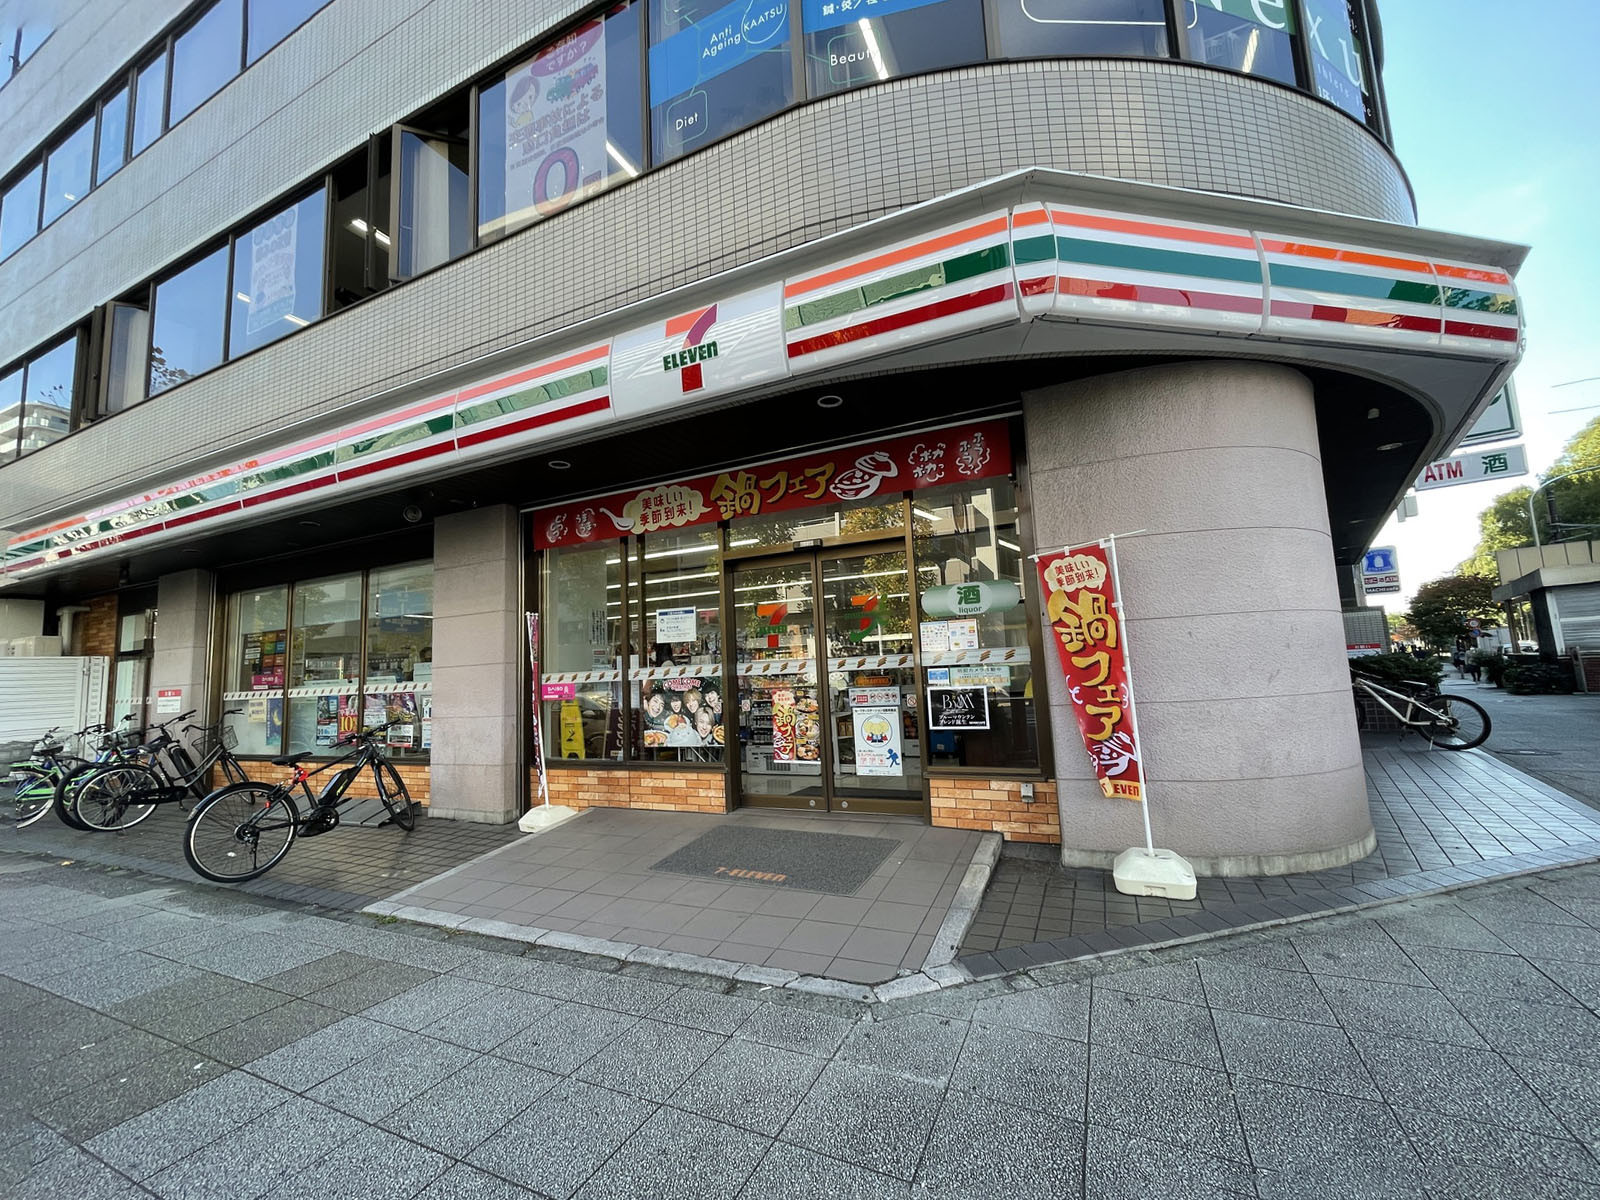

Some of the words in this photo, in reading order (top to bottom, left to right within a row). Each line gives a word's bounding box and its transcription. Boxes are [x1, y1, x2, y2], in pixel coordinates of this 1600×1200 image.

[743, 4, 784, 32] KAATSU
[710, 25, 733, 43] Anti
[702, 34, 741, 59] Ageing
[675, 113, 699, 131] Diet
[1424, 460, 1463, 483] ATM
[1481, 453, 1508, 475] 酒
[642, 491, 683, 512] 美味しい
[711, 462, 835, 520] 鍋フェア
[640, 500, 693, 527] 季節到来!
[1054, 560, 1090, 577] 美味しい
[1055, 567, 1100, 587] 季節到来!
[956, 585, 981, 605] 酒
[958, 606, 982, 614] liquor
[1047, 588, 1122, 742] 鍋フェア
